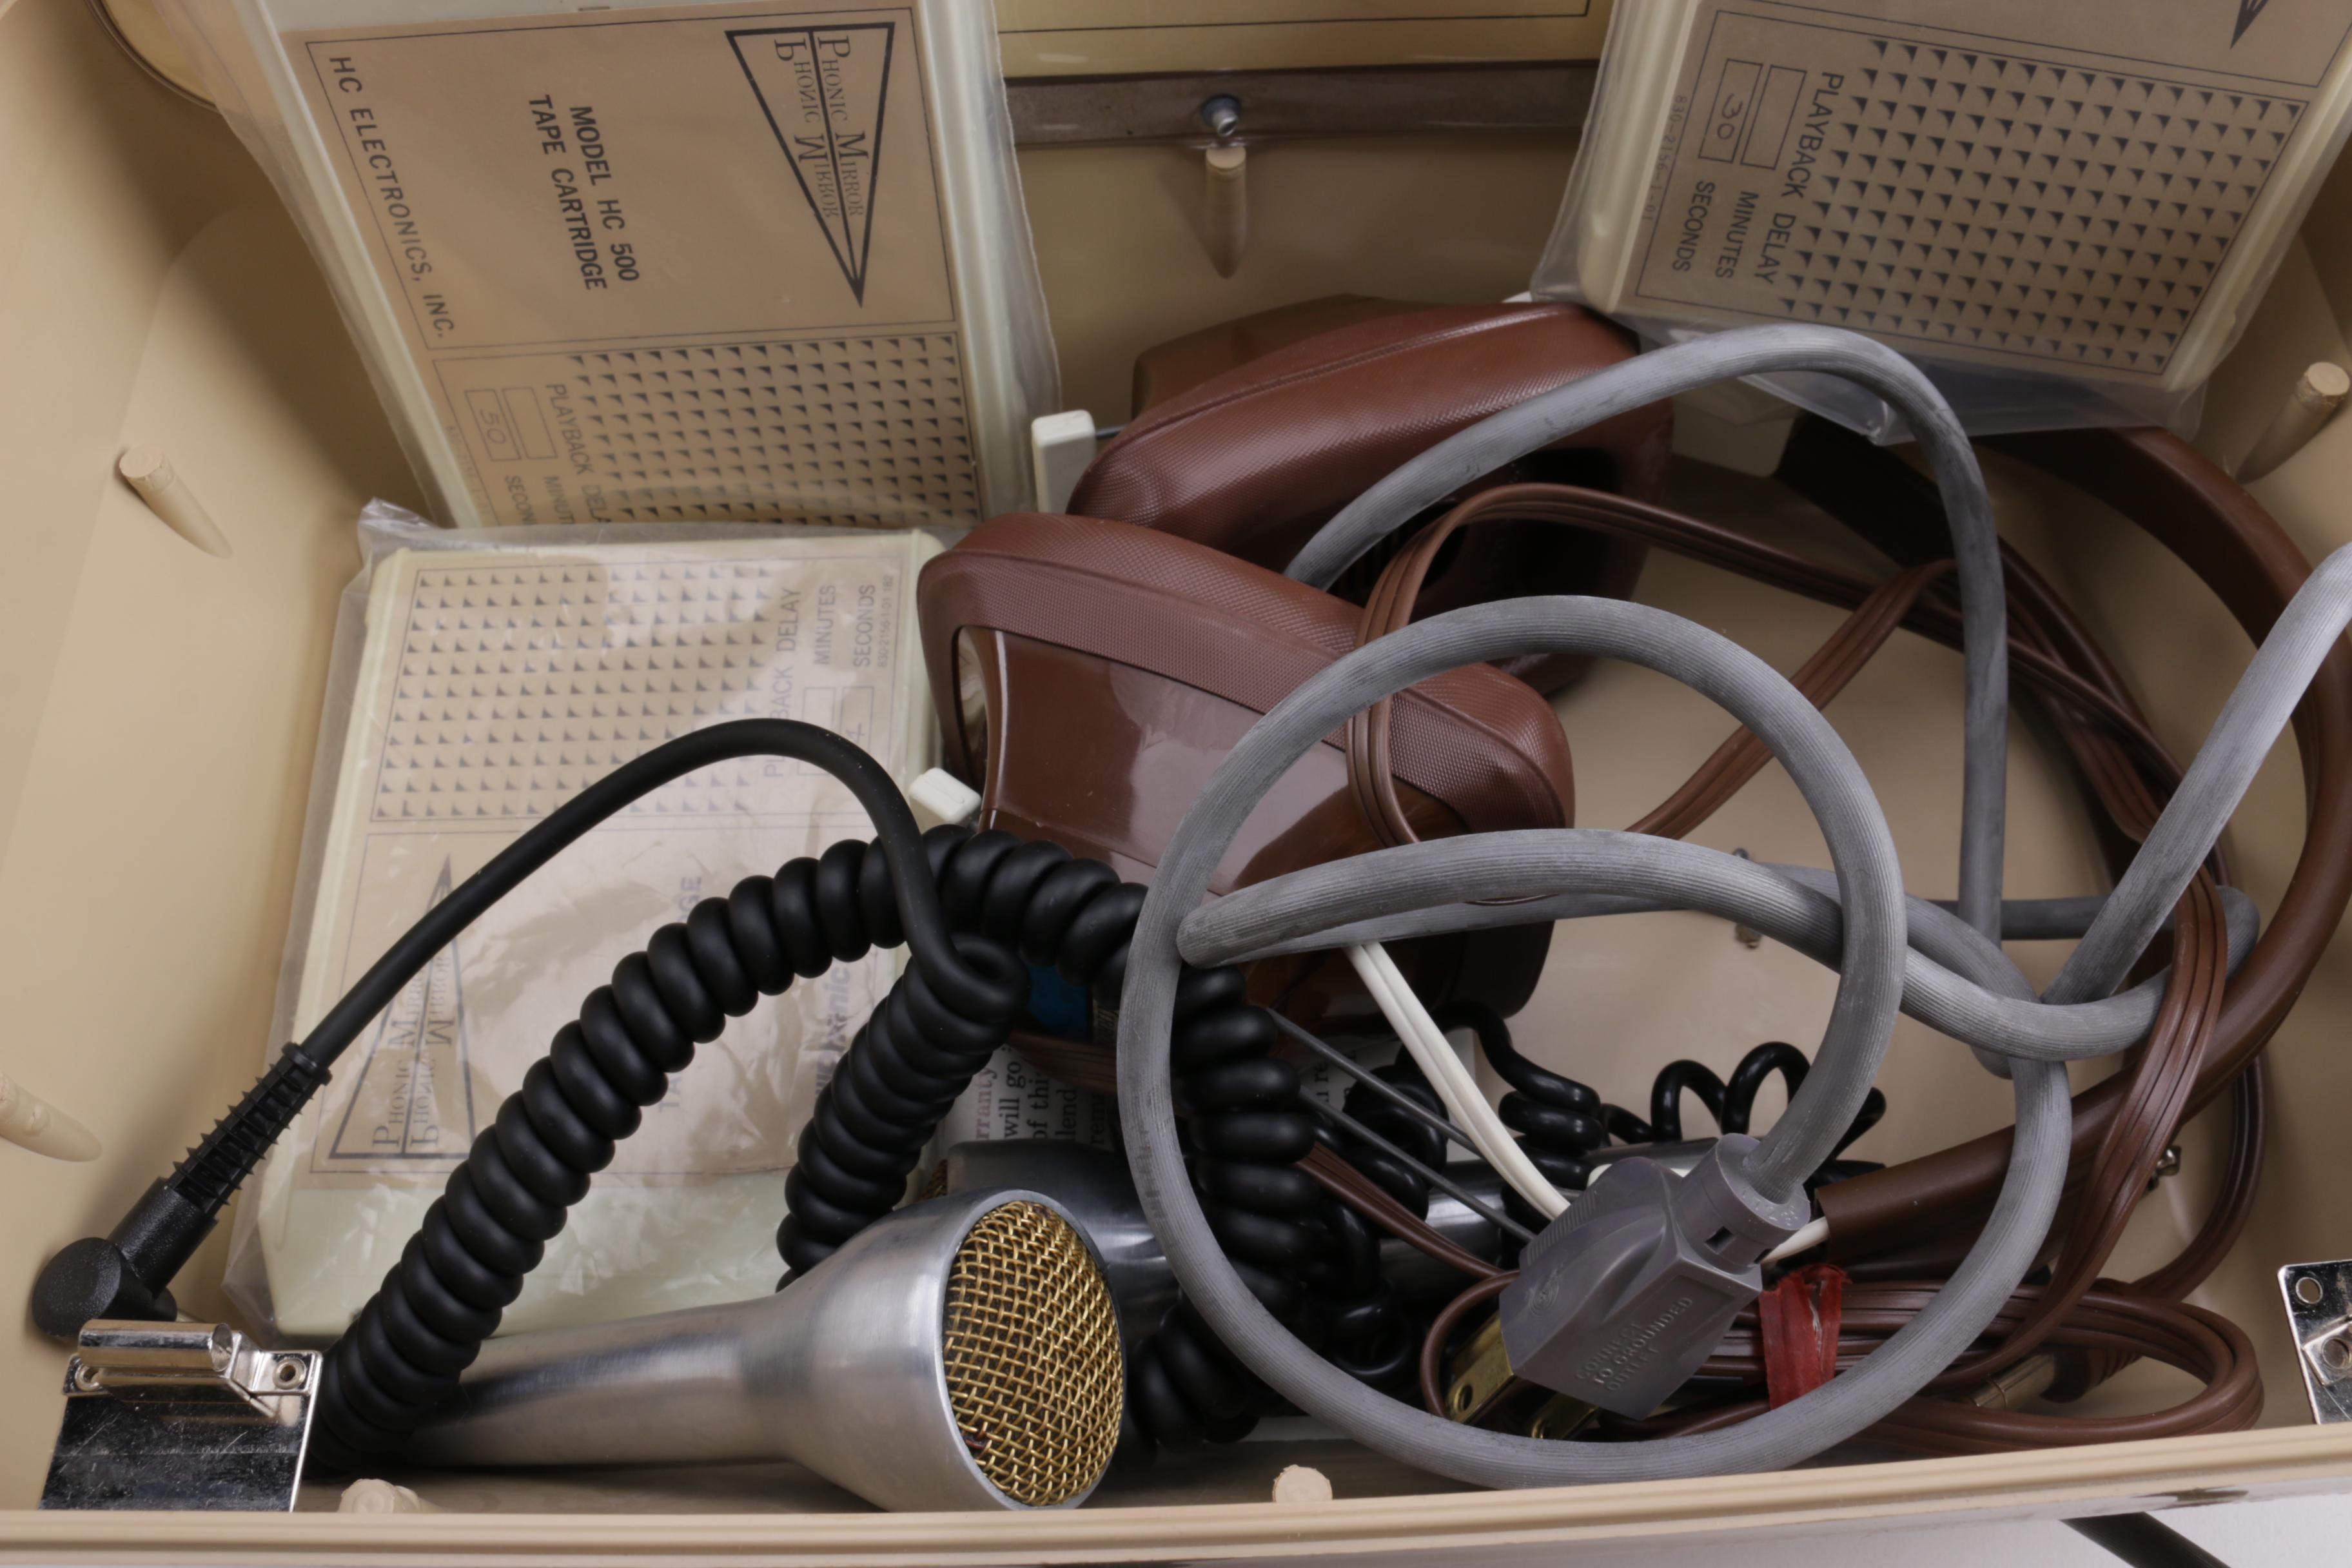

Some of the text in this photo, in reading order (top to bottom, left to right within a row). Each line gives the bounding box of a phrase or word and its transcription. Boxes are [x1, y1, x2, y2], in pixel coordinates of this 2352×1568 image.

[1716, 93, 1743, 141] 30
[329, 56, 455, 338] HC ELECTRONICS, INC.
[529, 94, 608, 290] TAPE CARTRIDGE
[569, 106, 640, 281] MODEL HC 500
[1754, 71, 1845, 286] PLAYBACK DELAY
[1672, 181, 1716, 273] SECONDS
[1715, 191, 1759, 279] MINUTES
[545, 384, 612, 524] PLAYBACK DELA
[504, 475, 537, 526] SECON
[543, 476, 576, 525] MINUT
[813, 584, 836, 665] MINUTES
[853, 583, 876, 668] SECONDS
[763, 587, 801, 778] PLBACK DELAY
[975, 1067, 997, 1140] rranty
[999, 1098, 1020, 1139] will
[1006, 1062, 1026, 1089] go
[1028, 1073, 1049, 1110] thi
[1591, 1297, 1693, 1384] TO GROUNDED
